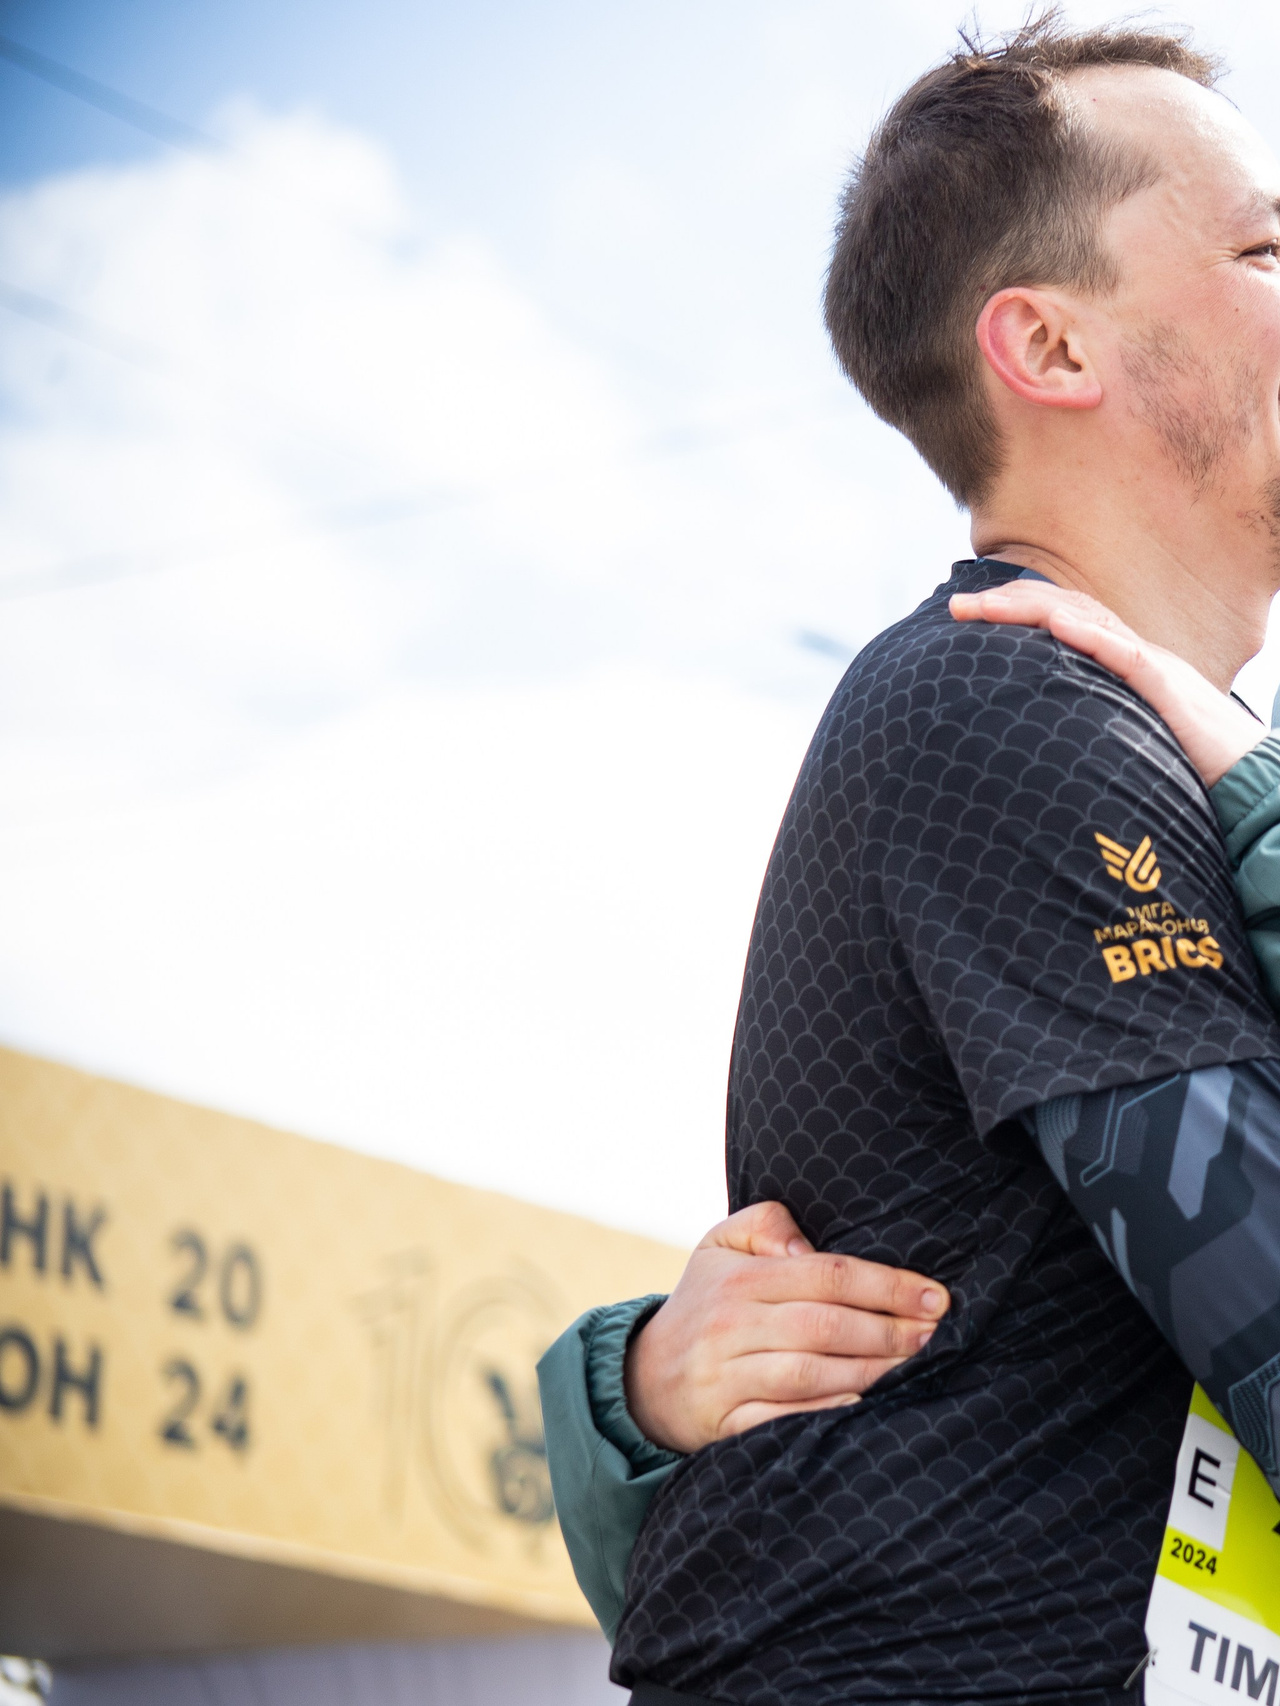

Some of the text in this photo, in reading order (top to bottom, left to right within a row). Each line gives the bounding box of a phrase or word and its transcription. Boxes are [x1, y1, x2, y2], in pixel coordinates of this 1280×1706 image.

[1102, 936, 1224, 983] BRICS
[167, 1224, 264, 1331] 20
[157, 1352, 253, 1456] 24
[1187, 1447, 1221, 1509] E
[1170, 1537, 1218, 1576] 2024
